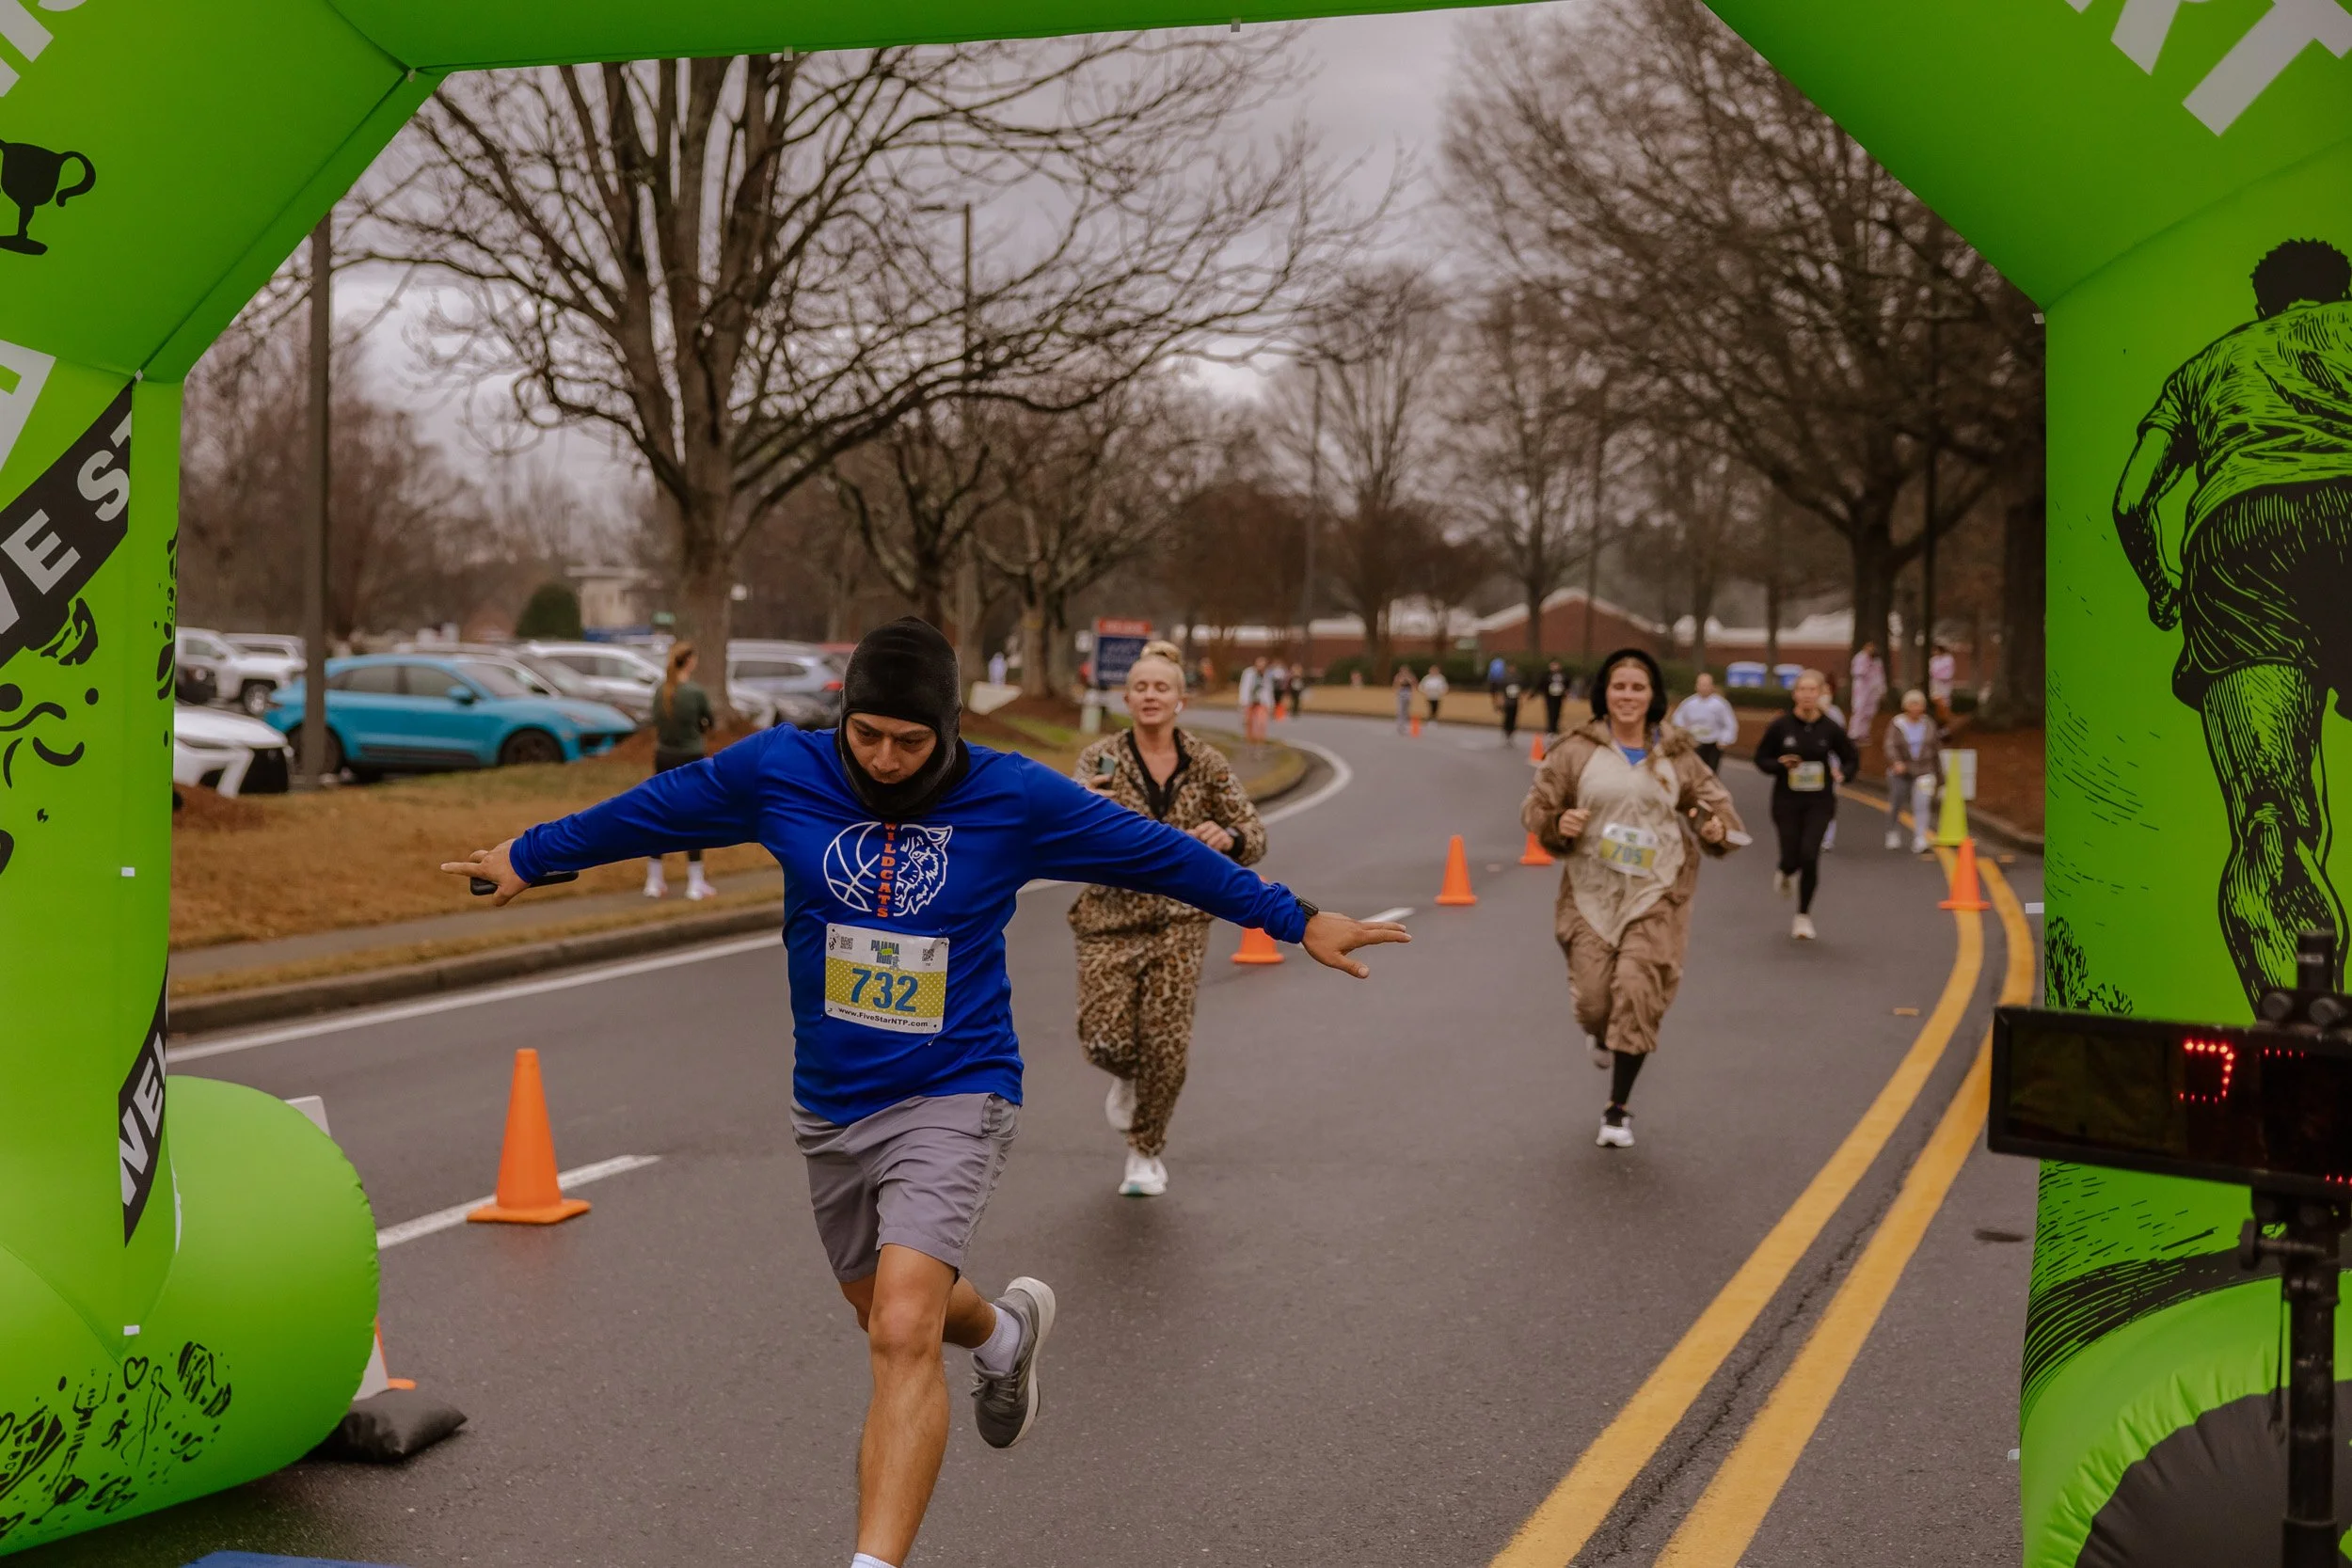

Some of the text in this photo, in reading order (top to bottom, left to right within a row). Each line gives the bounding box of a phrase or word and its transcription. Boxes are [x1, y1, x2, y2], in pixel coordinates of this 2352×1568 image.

[877, 822, 897, 918] WILDCATS
[850, 967, 918, 1013] 732
[837, 1006, 929, 1028] www.FiveStarNTP.com
